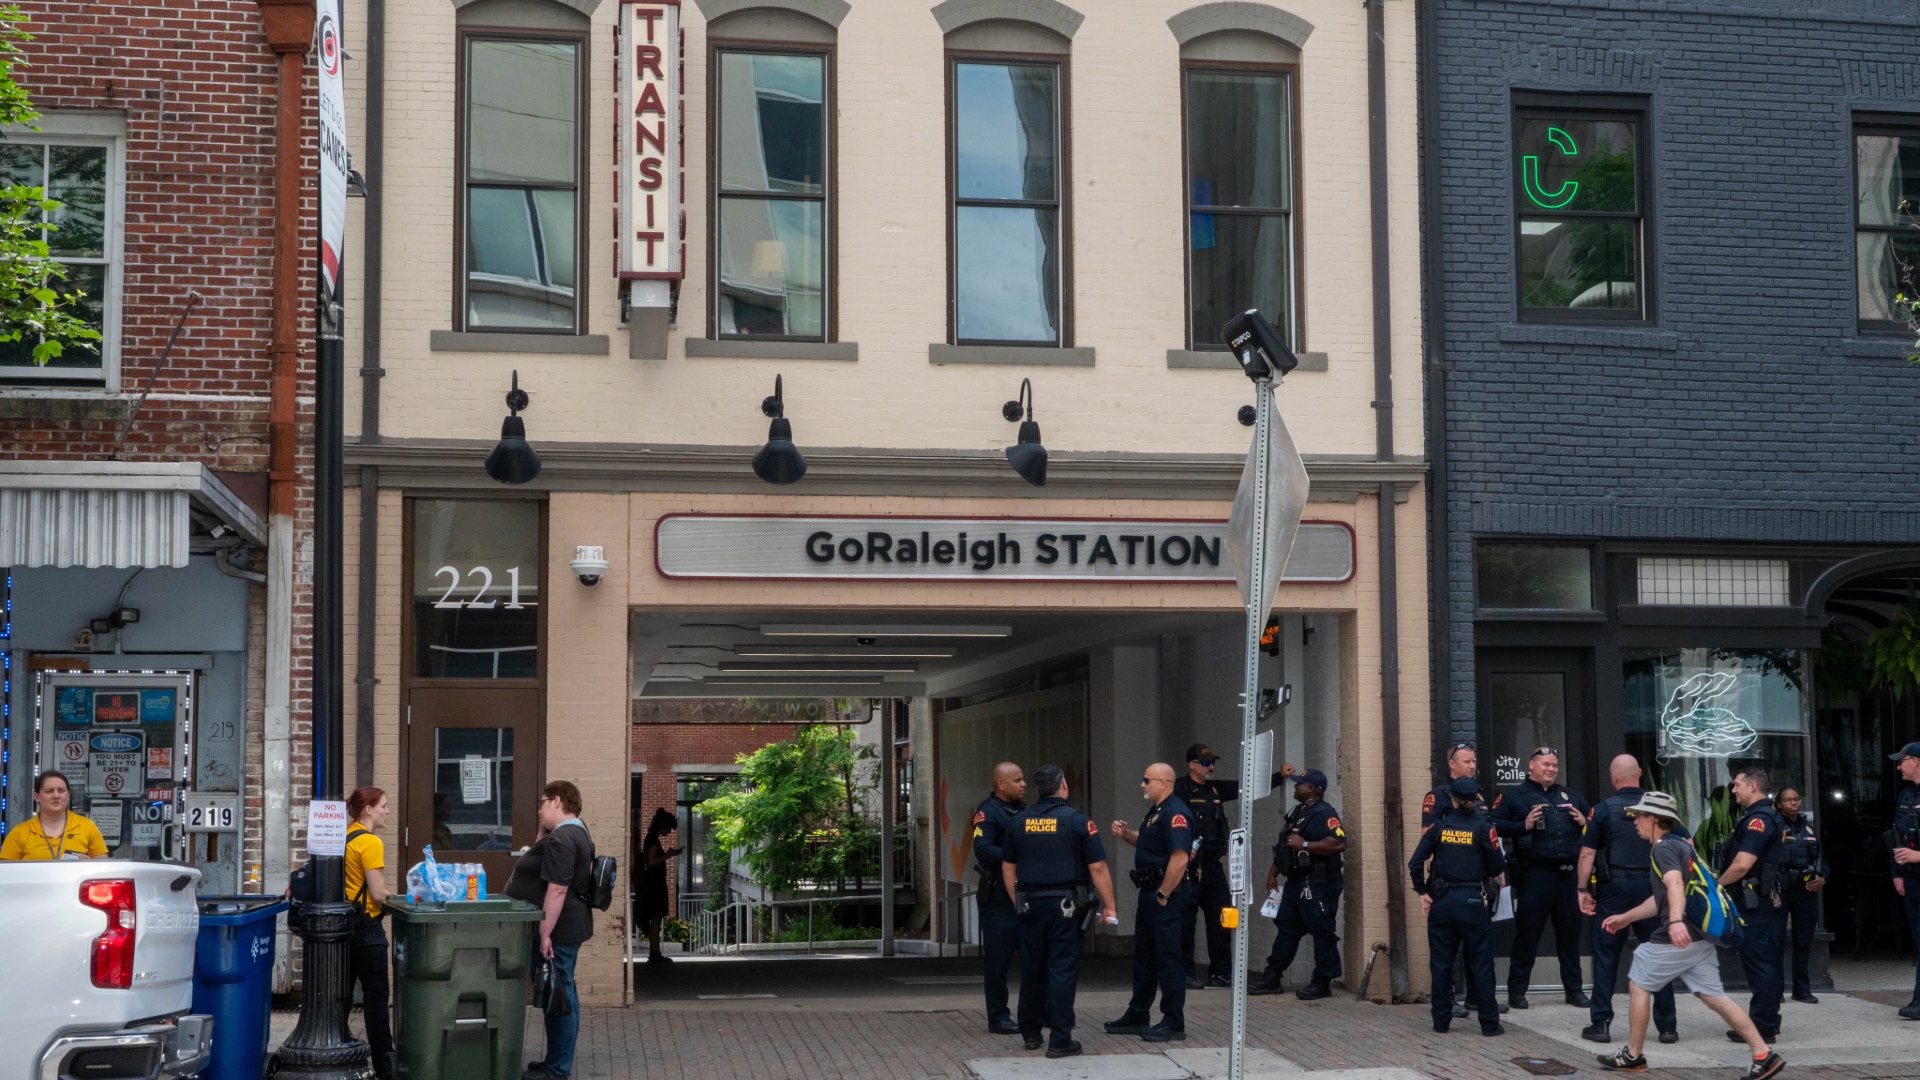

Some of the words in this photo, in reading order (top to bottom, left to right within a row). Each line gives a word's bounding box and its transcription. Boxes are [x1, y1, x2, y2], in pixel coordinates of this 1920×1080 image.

[635, 8, 666, 264] TRANSIT
[321, 119, 345, 177] CANES
[1233, 331, 1251, 345] TAPCO
[806, 531, 1020, 570] GoRaleigh
[1036, 534, 1221, 567] STATION
[434, 565, 524, 610] 221
[112, 696, 121, 707] NO
[97, 707, 136, 719] TRESPASSING
[211, 721, 234, 739] 219
[101, 738, 131, 747] NOTICE
[1496, 755, 1520, 768] City
[465, 769, 472, 778] NO
[1497, 769, 1526, 780] Colle
[149, 791, 158, 799] NO
[160, 791, 172, 799] EBT
[135, 806, 160, 820] NO
[192, 807, 232, 826] 219
[1441, 836, 1473, 844] POLICE
[1442, 830, 1473, 838] RALEIGH
